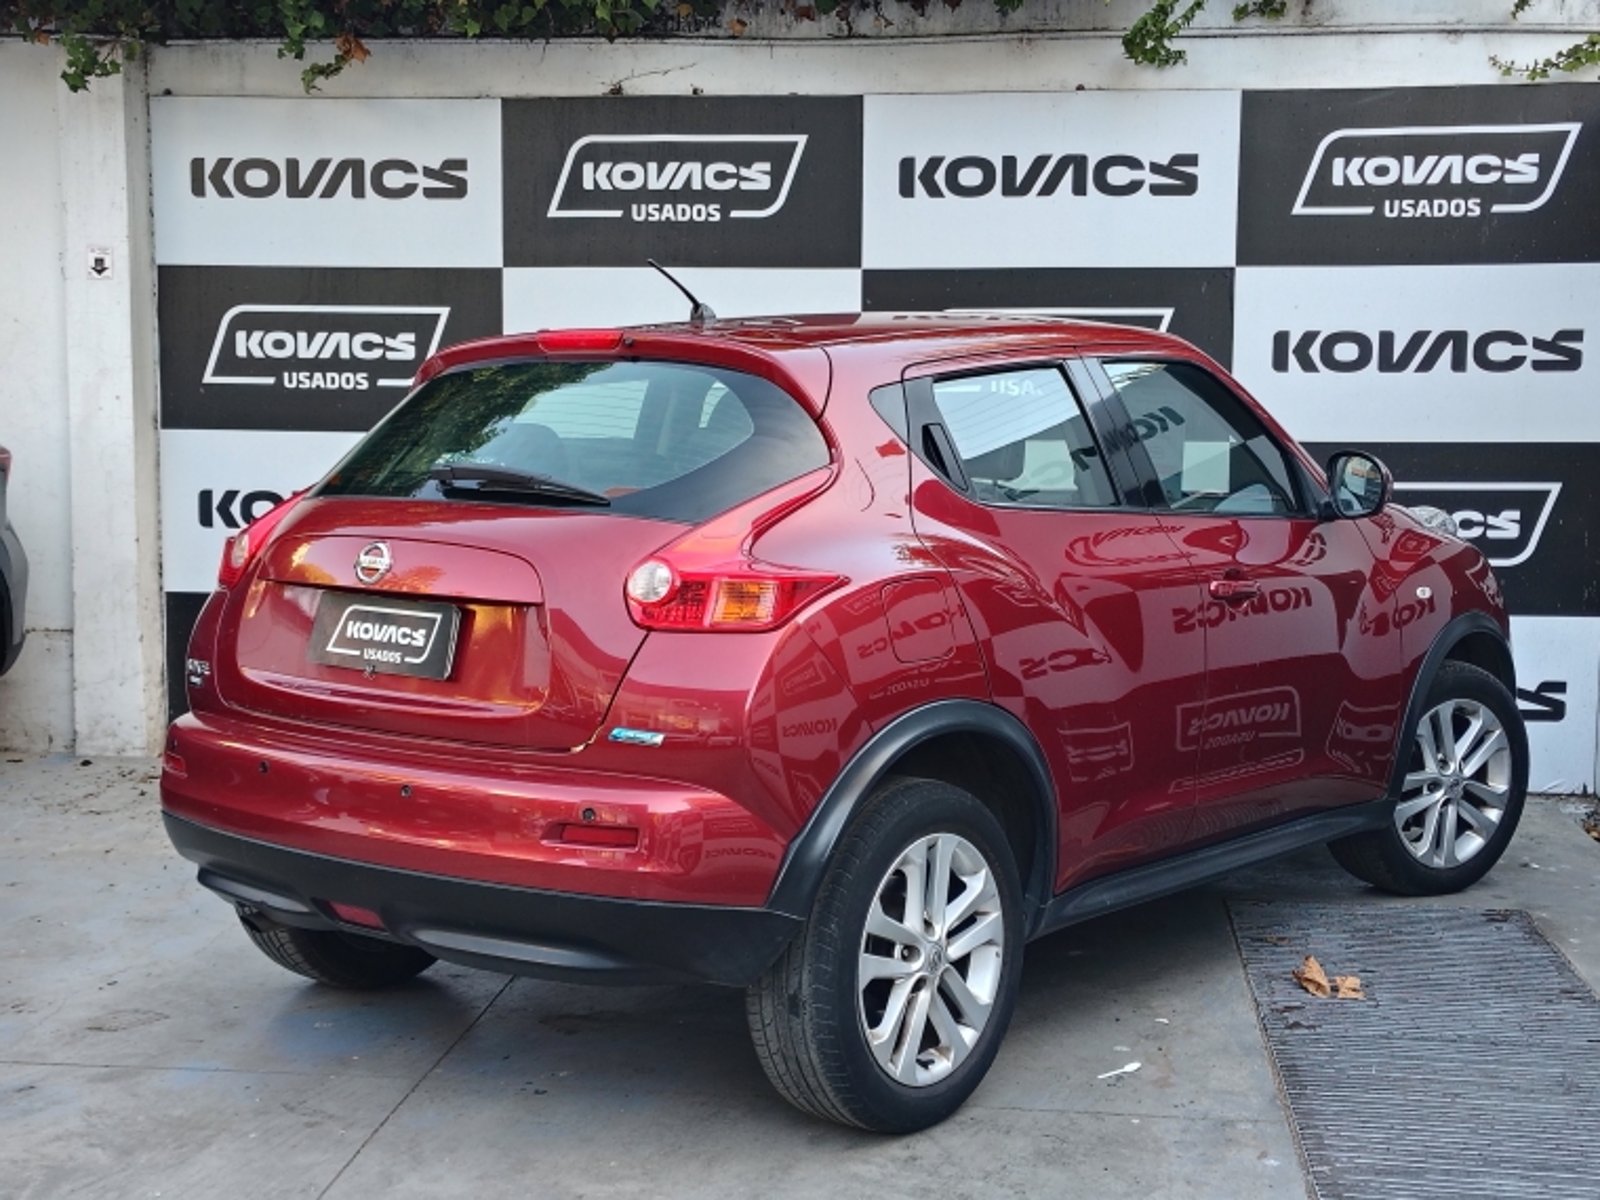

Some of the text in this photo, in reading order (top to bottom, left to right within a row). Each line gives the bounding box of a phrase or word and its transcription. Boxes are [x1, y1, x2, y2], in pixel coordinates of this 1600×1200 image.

[190, 157, 468, 199] KOVACS
[582, 161, 771, 190] KOVACS
[899, 153, 1199, 198] KOVACS
[1332, 153, 1540, 186] KOVACS
[631, 203, 721, 222] USADOS
[1384, 198, 1481, 218] USADOS
[235, 330, 416, 361] KOVACS
[1272, 328, 1585, 373] KOVACS
[283, 371, 369, 390] USADOS
[346, 620, 427, 648] KOVACS
